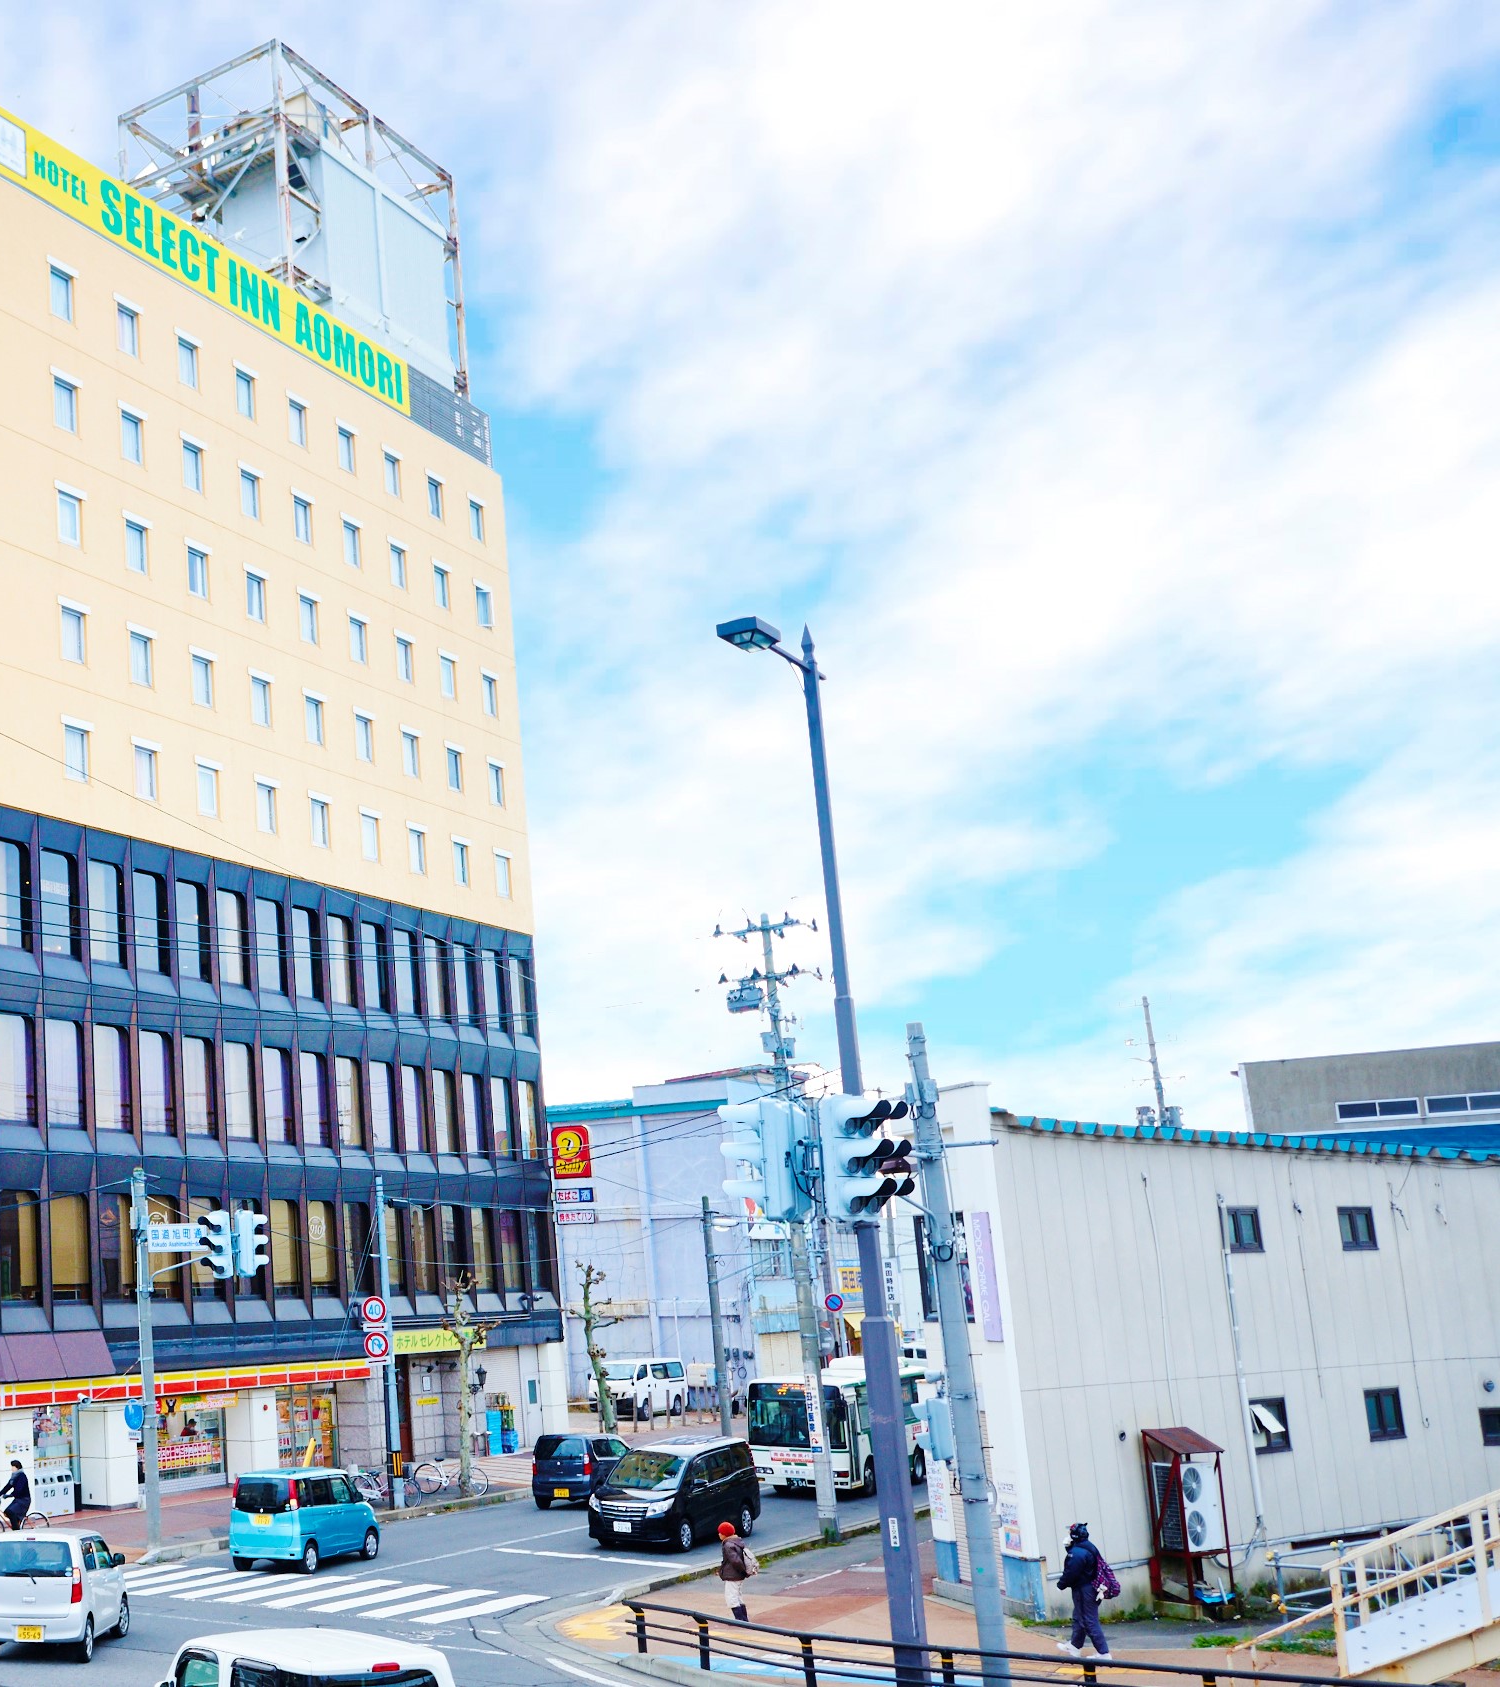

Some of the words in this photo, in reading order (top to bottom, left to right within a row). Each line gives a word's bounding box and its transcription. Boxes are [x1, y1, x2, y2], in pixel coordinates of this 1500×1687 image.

[34, 151, 89, 206] HOTEL
[100, 179, 220, 294] SELECT
[228, 258, 281, 333] INN
[295, 301, 404, 406] AOMORI
[556, 1159, 588, 1173] Daily
[557, 1191, 578, 1201] たばこ
[580, 1190, 591, 1201] 酒
[559, 1212, 593, 1222] 焼きたてパン
[972, 1219, 983, 1253] MODE
[884, 1261, 895, 1301] 岡田時計店
[977, 1255, 989, 1296] FORME
[368, 1304, 381, 1316] 40
[396, 1333, 419, 1349] ホテル
